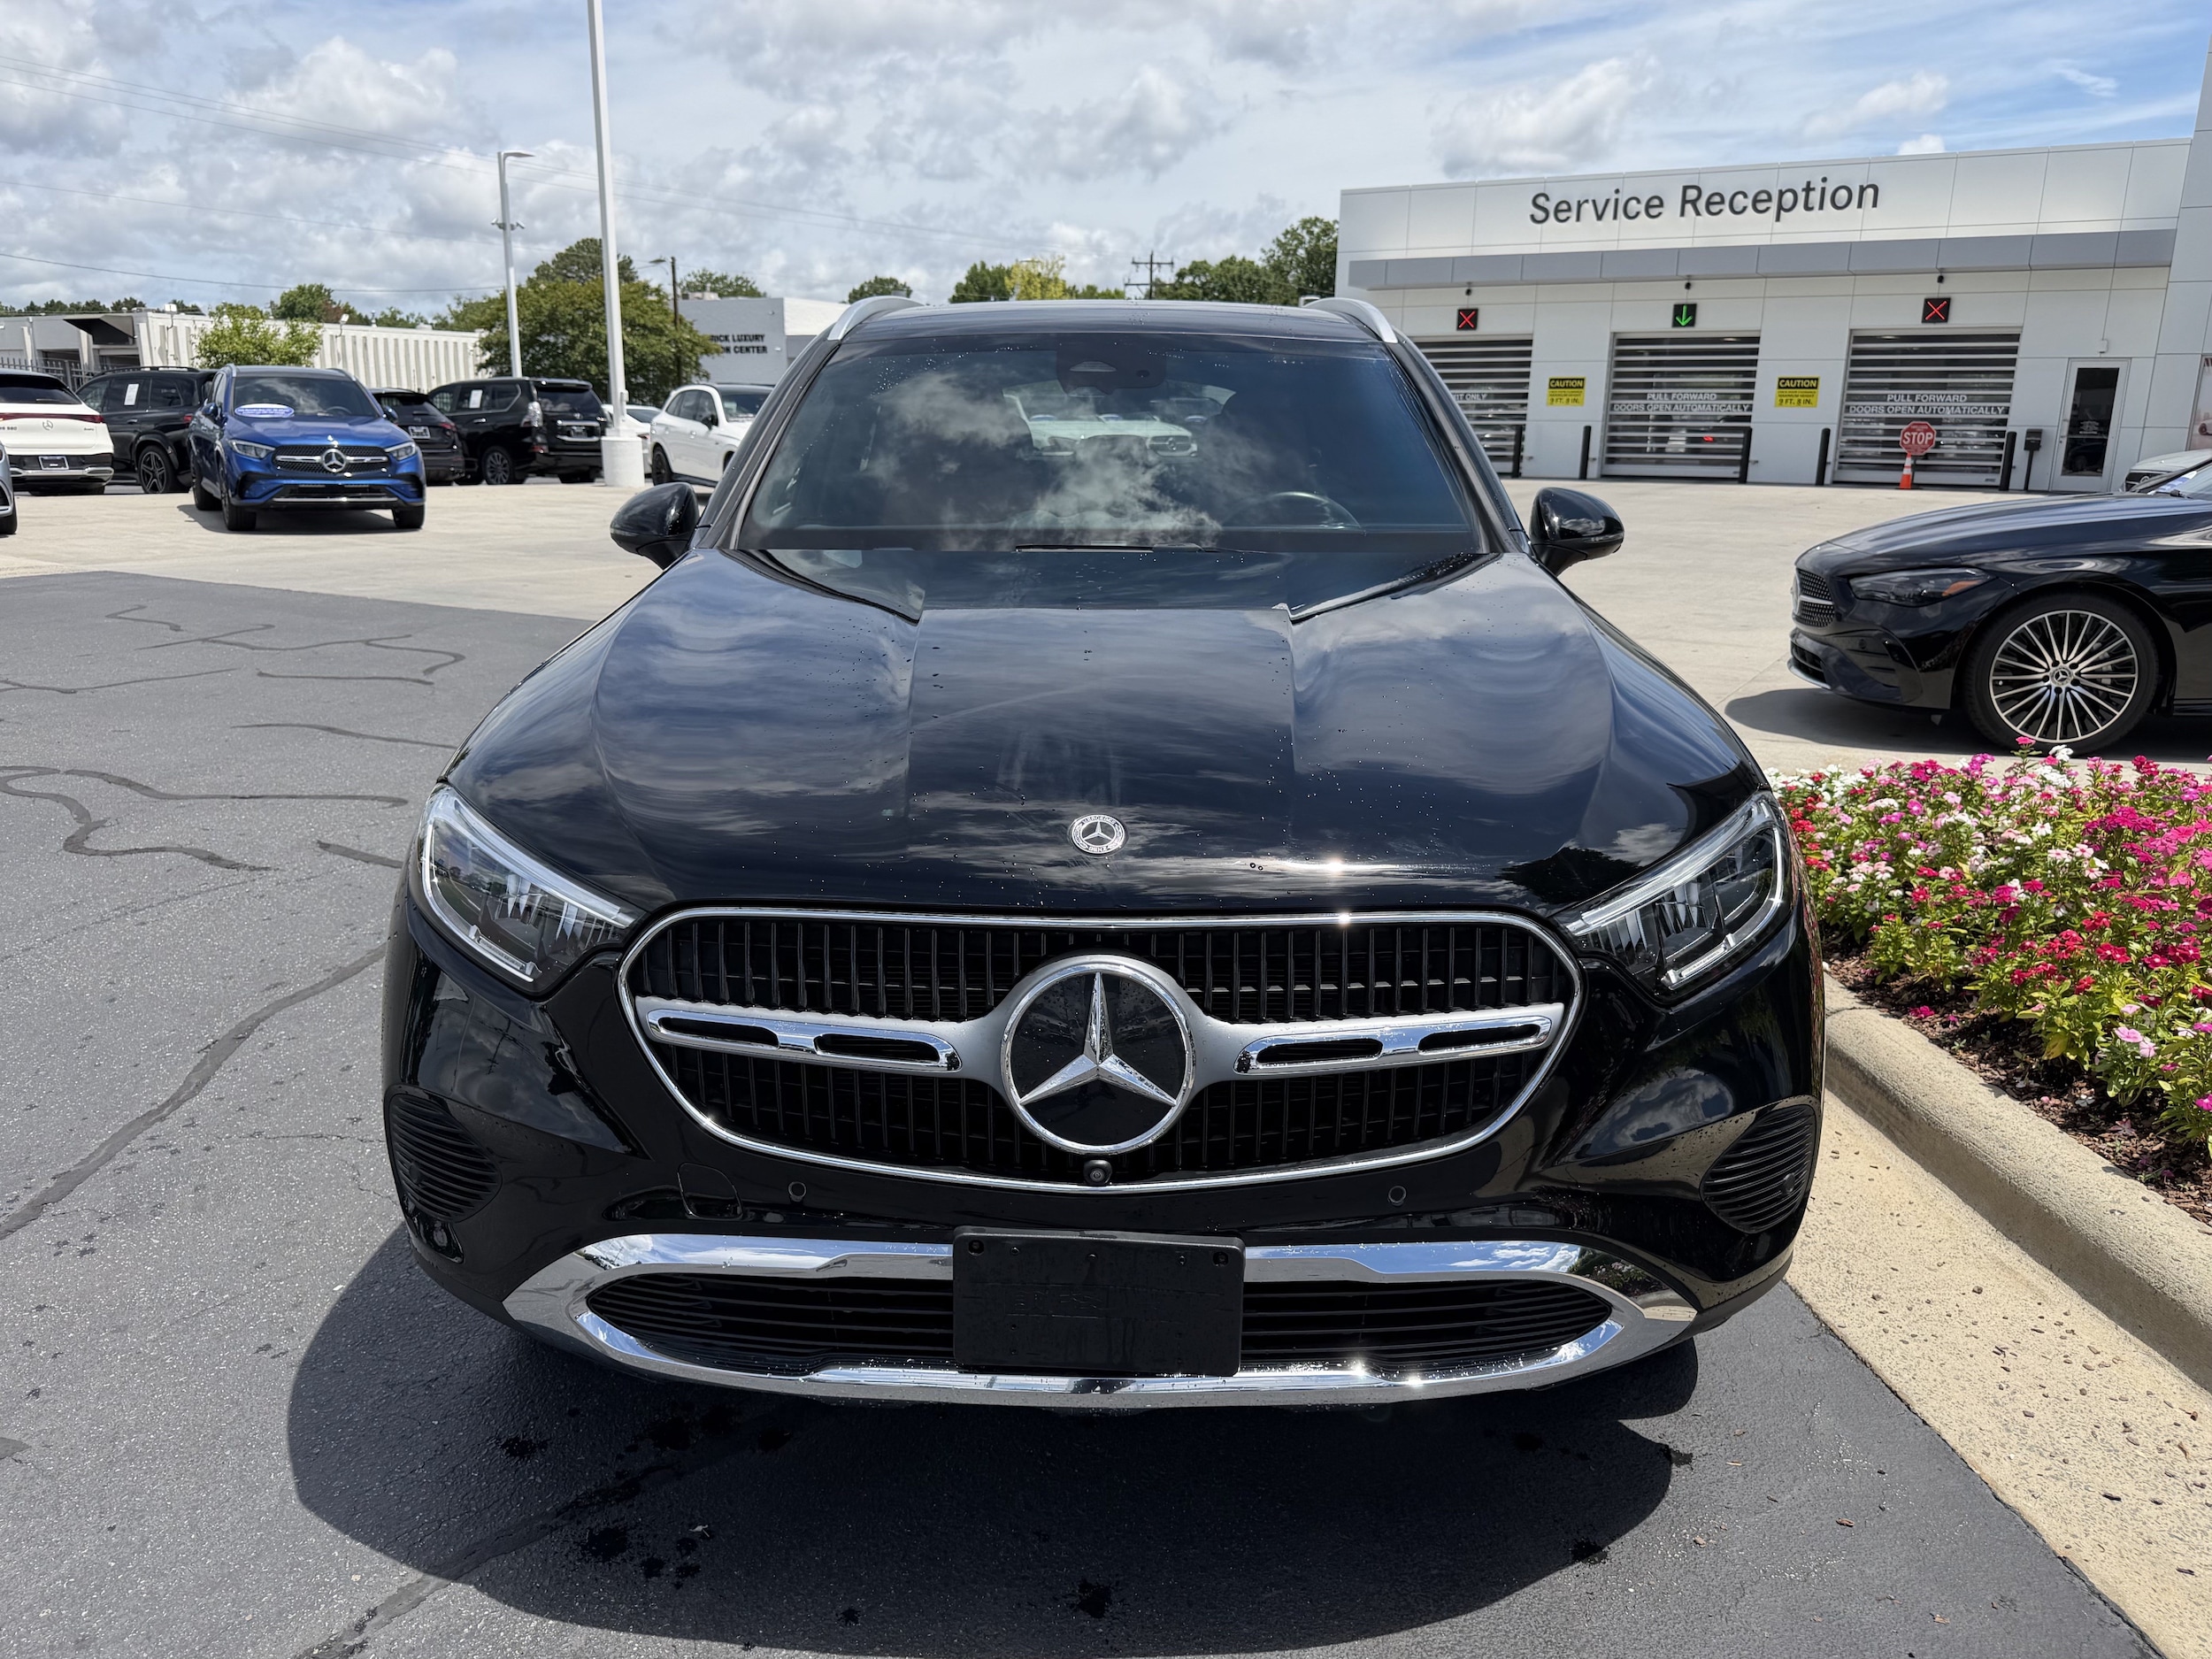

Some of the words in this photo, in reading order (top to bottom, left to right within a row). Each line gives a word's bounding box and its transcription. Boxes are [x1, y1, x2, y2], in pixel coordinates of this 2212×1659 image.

[1529, 188, 1664, 225] Service
[1678, 176, 1880, 223] Reception
[732, 334, 764, 342] LUXURY
[1886, 394, 1912, 403] PULL
[1915, 394, 1967, 403] FORWARD
[1672, 403, 1749, 412] AUTOMATICALLY
[1849, 405, 1885, 414] DOORS
[1916, 406, 2005, 415] AUTOMATICALLY
[1902, 432, 1933, 444] STOP
